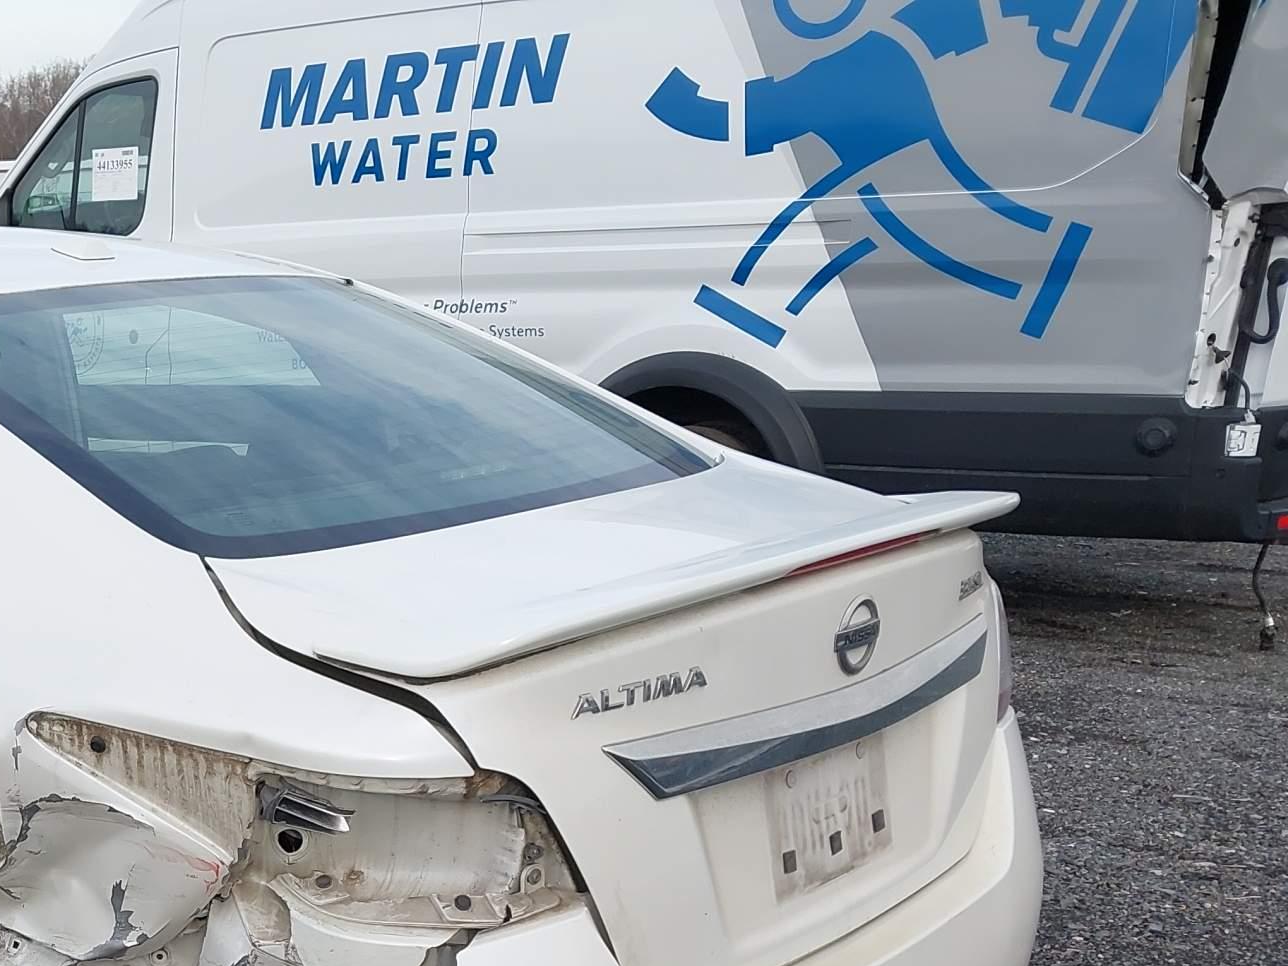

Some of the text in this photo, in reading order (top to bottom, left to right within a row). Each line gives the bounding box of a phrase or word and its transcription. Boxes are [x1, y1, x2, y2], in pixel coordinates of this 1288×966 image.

[259, 33, 571, 130] MARTIN
[96, 159, 133, 171] 44133955
[310, 127, 498, 187] WATER
[489, 324, 545, 339] Systems
[570, 665, 708, 721] ALTIMA
